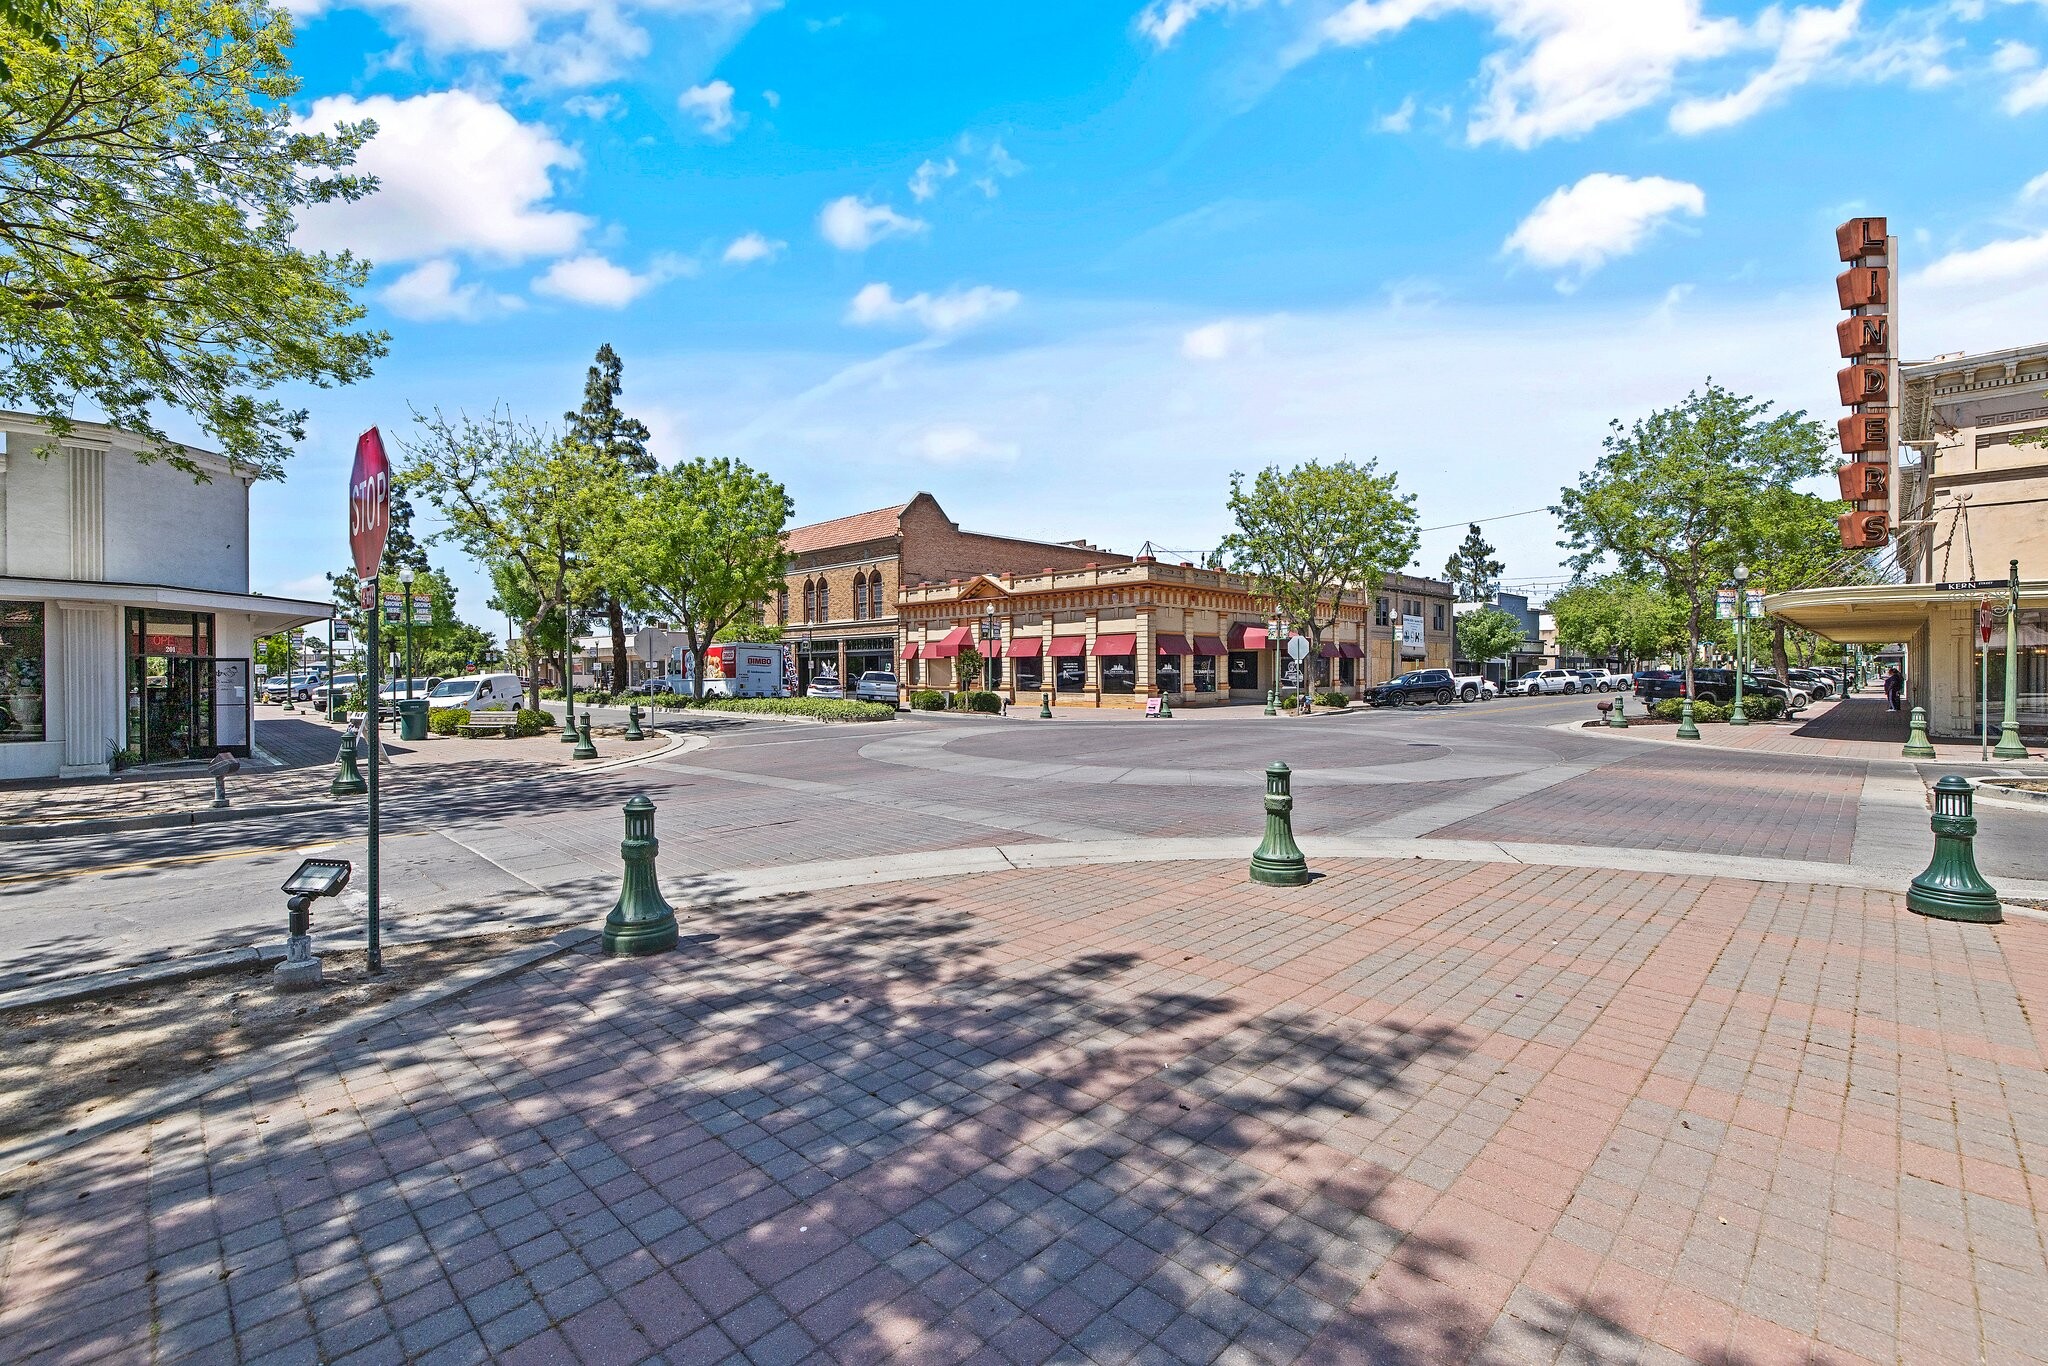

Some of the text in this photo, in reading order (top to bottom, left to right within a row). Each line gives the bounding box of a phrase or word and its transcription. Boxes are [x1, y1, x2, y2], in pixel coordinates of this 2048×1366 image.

[1862, 221, 1887, 543] LINDERS
[352, 471, 386, 537] STOP
[1948, 582, 1976, 590] KERN
[153, 636, 177, 647] OPE
[747, 657, 772, 665] BIMBO
